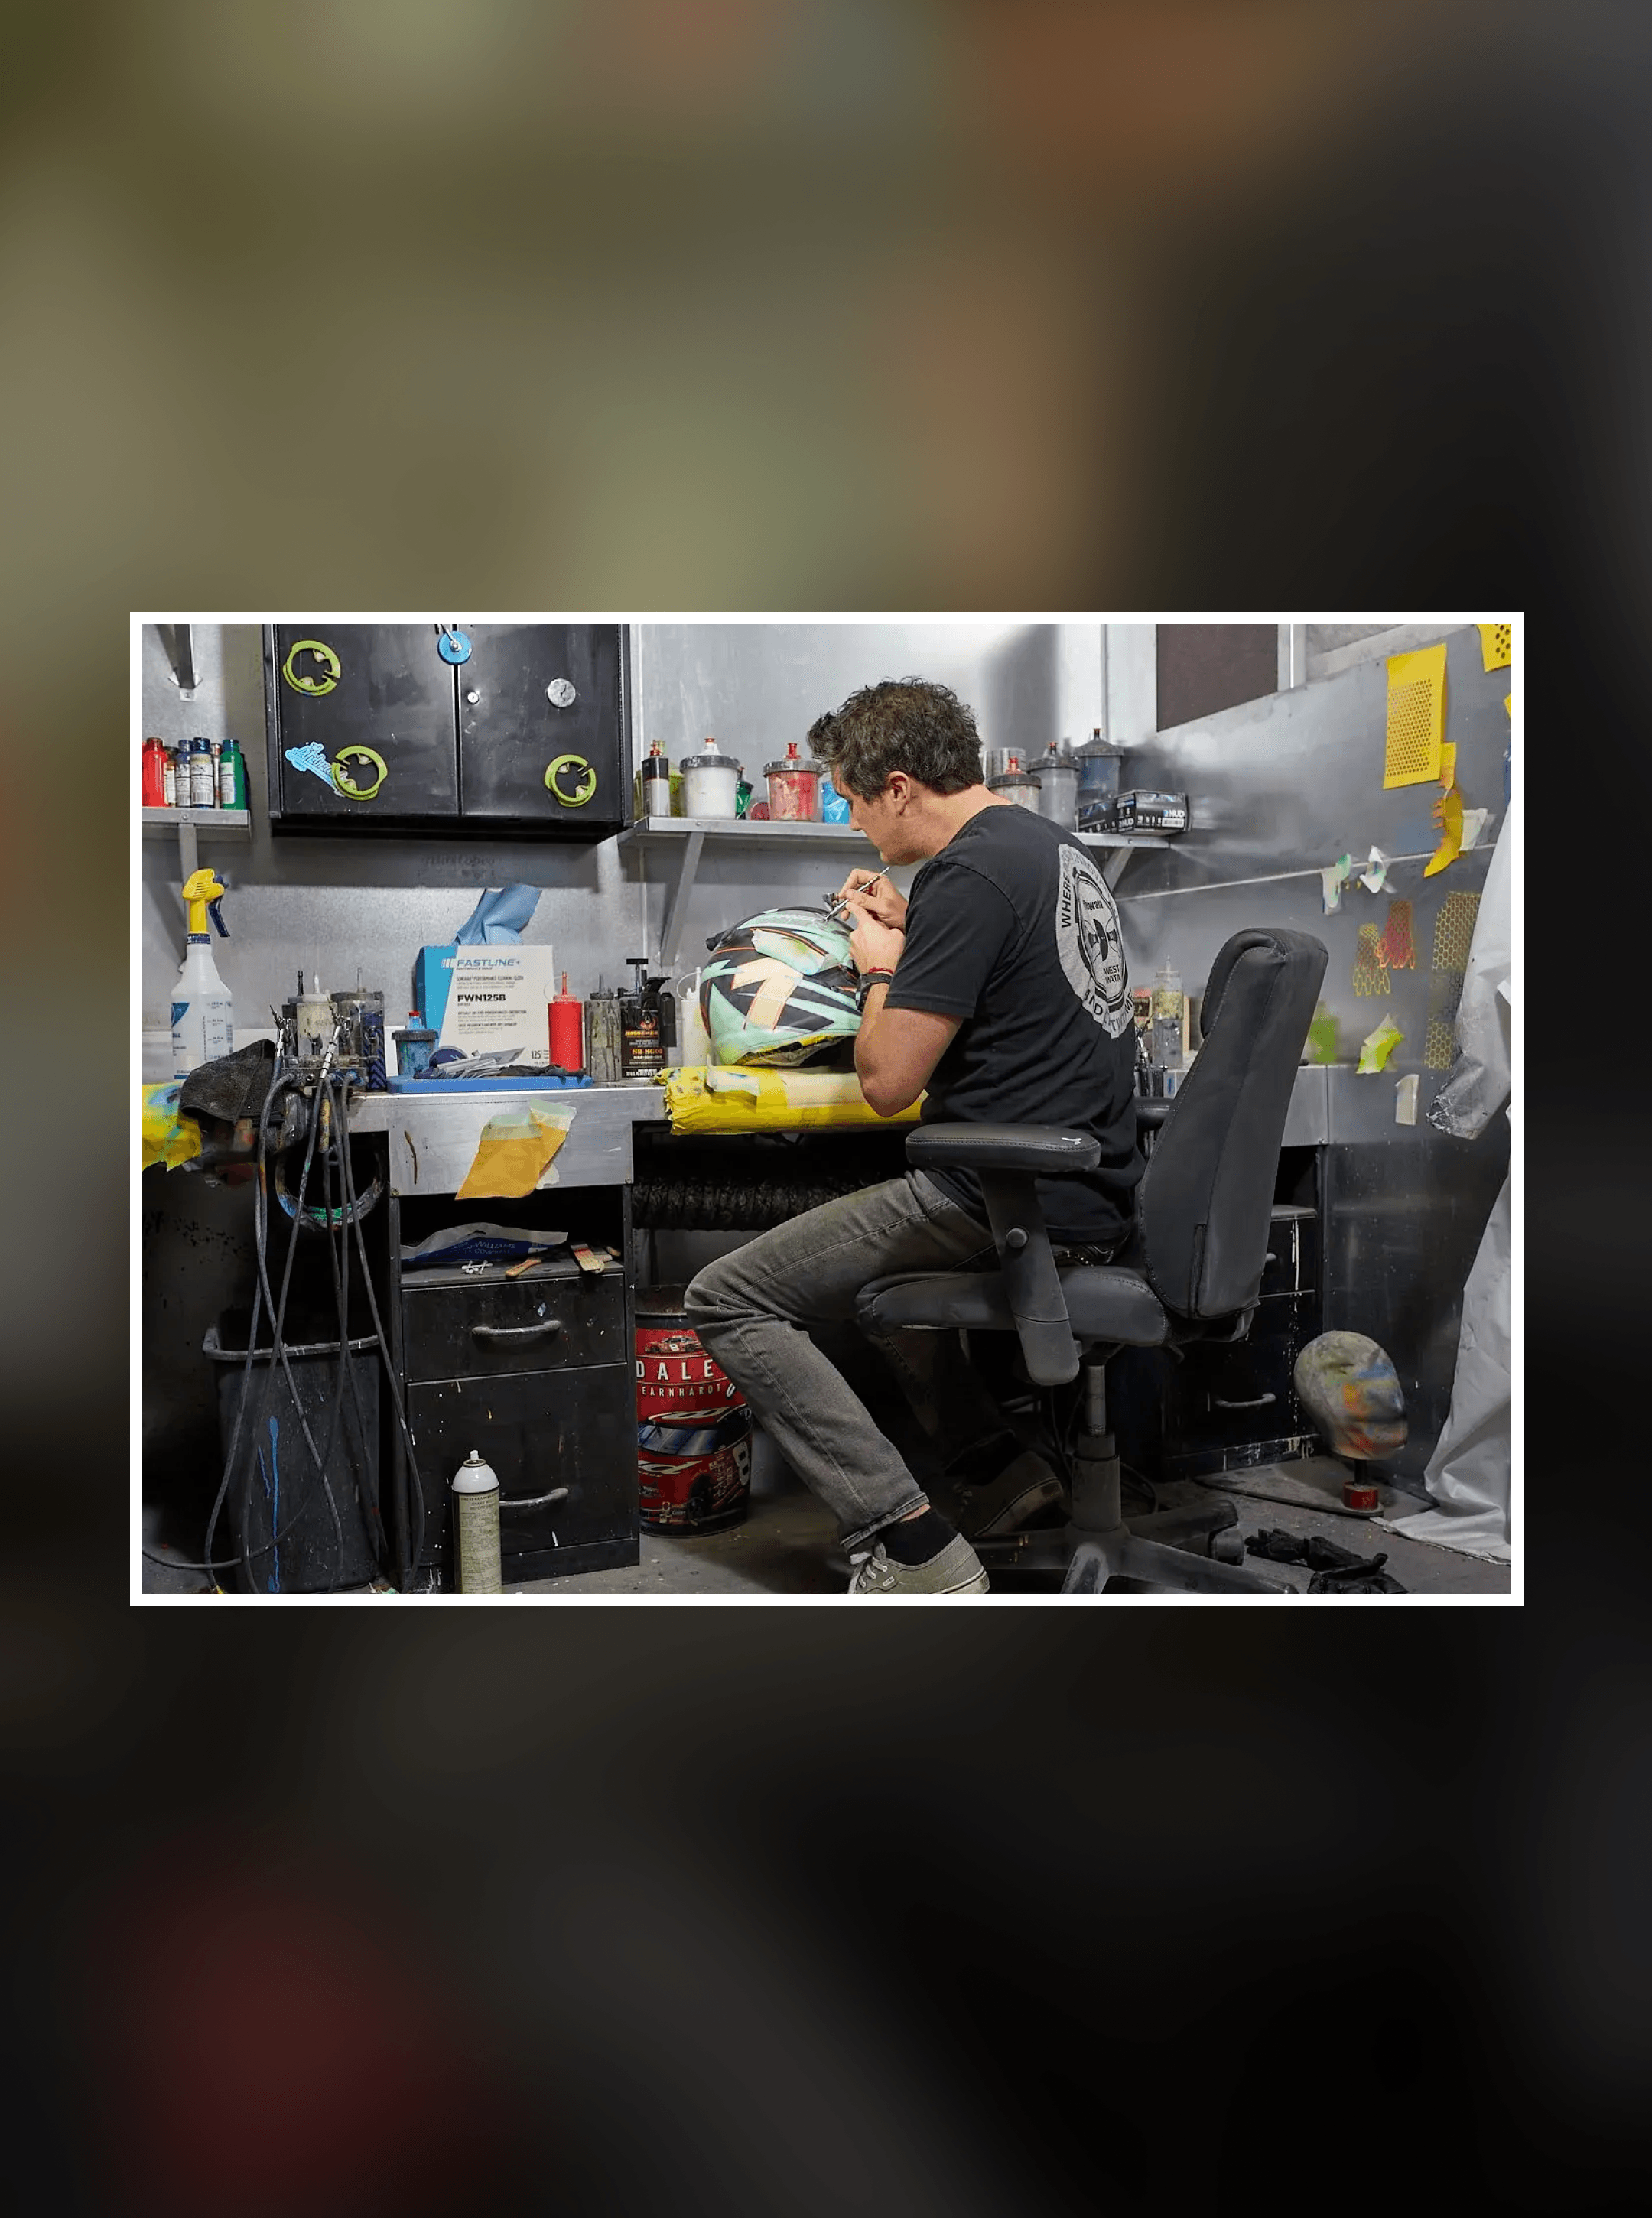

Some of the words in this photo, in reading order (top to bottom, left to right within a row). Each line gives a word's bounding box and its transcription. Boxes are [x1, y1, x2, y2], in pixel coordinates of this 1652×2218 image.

[1061, 873, 1072, 929] WHERE
[457, 959, 520, 968] FASTLINE+
[457, 994, 506, 1002] FWN125B
[532, 1050, 541, 1059] 125
[636, 1358, 714, 1381] DALE
[642, 1383, 721, 1397] EARNHARDT
[733, 1441, 750, 1486] 8
